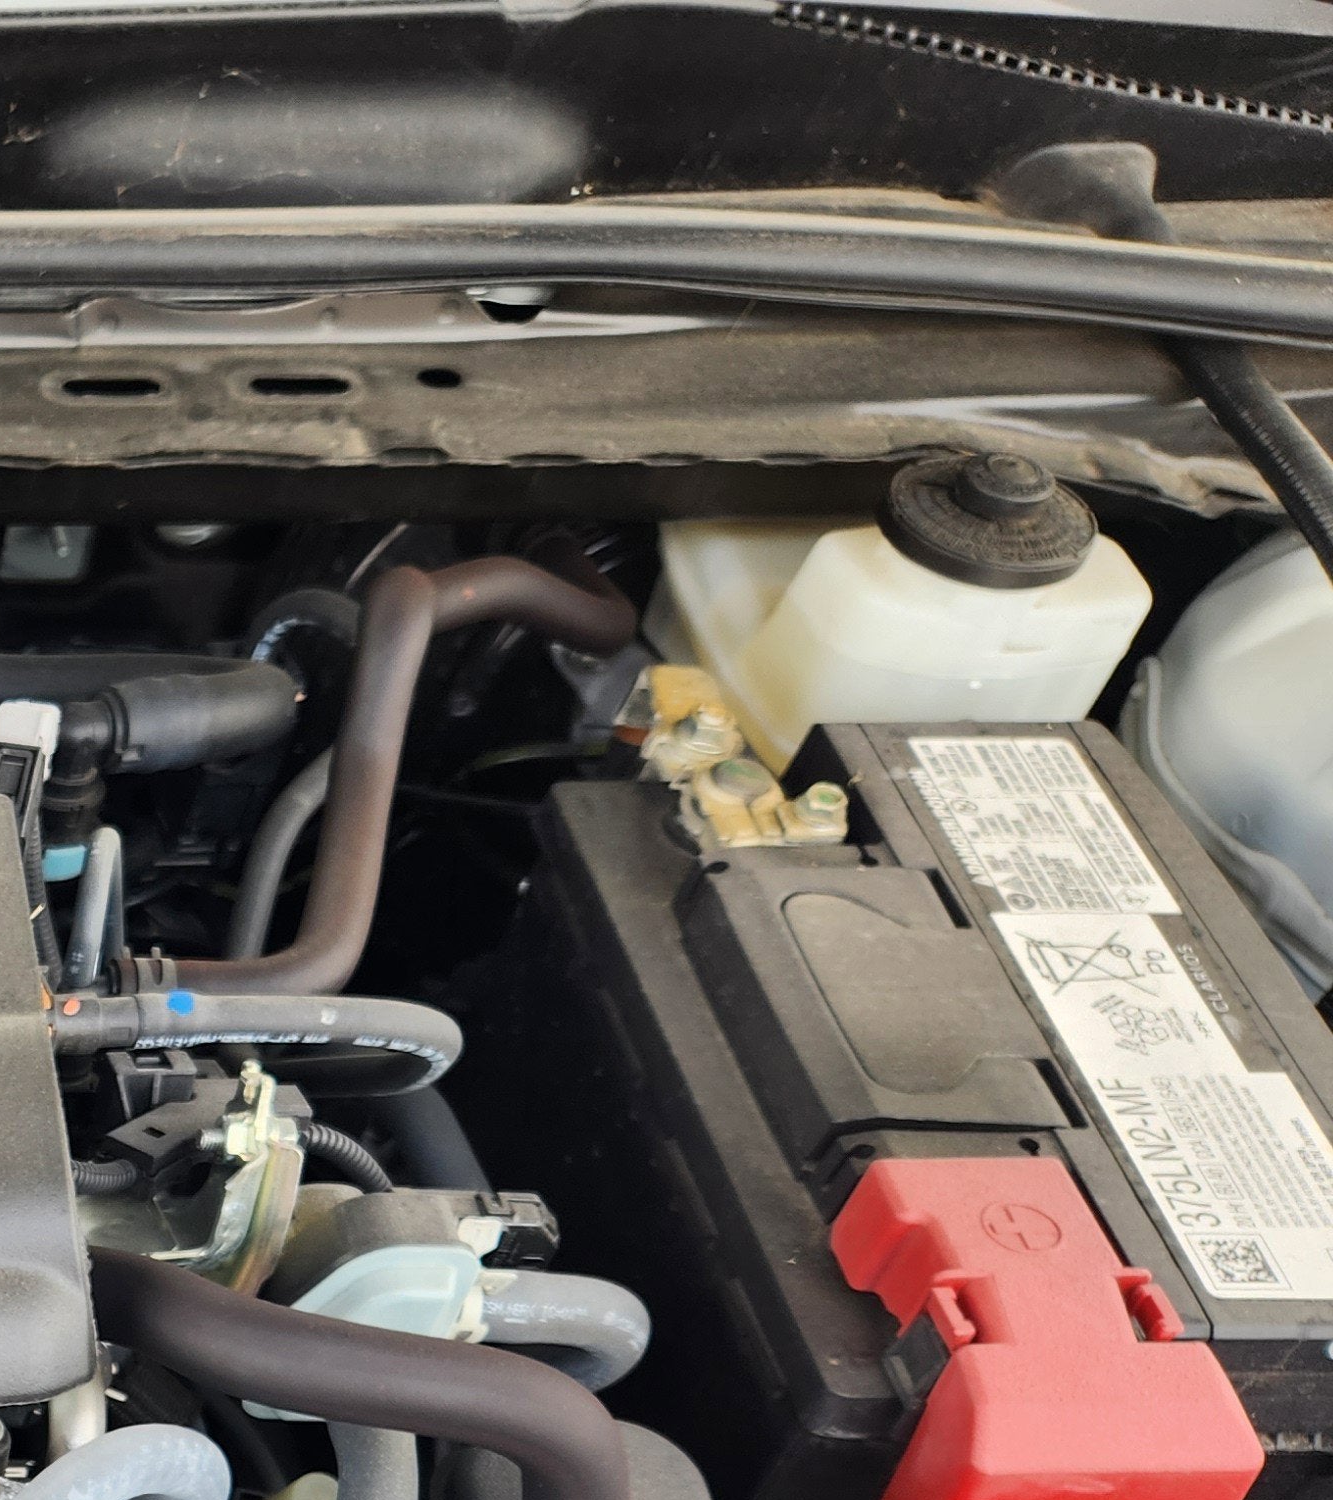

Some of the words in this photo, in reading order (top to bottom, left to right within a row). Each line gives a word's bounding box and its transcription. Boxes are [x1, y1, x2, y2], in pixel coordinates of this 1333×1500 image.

[1144, 950, 1173, 974] Pb
[1175, 944, 1229, 1012] CLARIOS
[1096, 1078, 1223, 1227] 375LN2-MF
